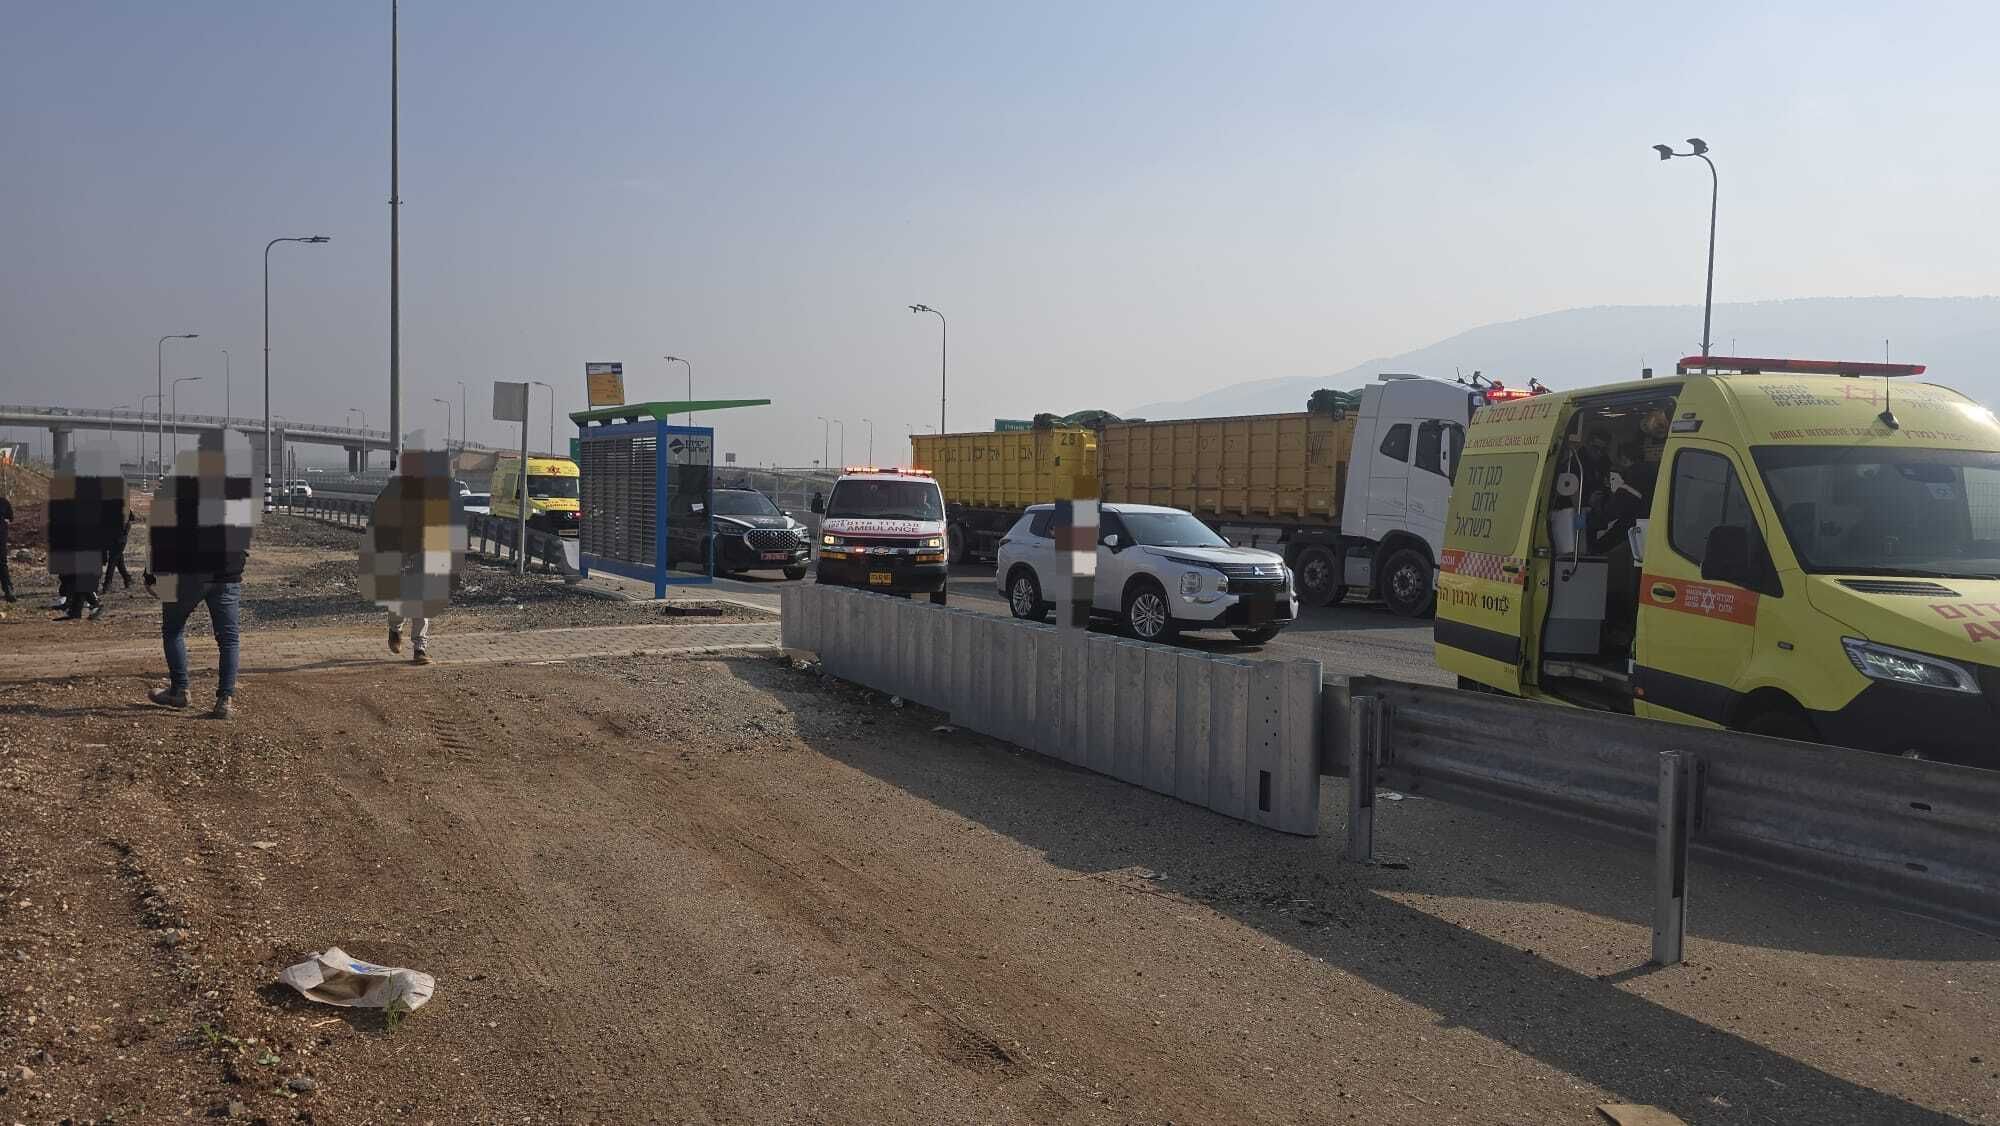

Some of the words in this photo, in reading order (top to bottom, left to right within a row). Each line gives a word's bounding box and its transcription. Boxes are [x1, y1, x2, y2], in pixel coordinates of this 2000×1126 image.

[1487, 406, 1518, 423] טיפול
[1519, 402, 1552, 421] ניידת
[1468, 466, 1485, 486] דוד
[1483, 465, 1503, 489] מגן
[1471, 491, 1498, 512] אדום
[846, 525, 919, 533] AMBULANCE
[1455, 512, 1492, 538] בישראל
[1452, 588, 1478, 609] ארגון
[1482, 595, 1499, 612] 101
